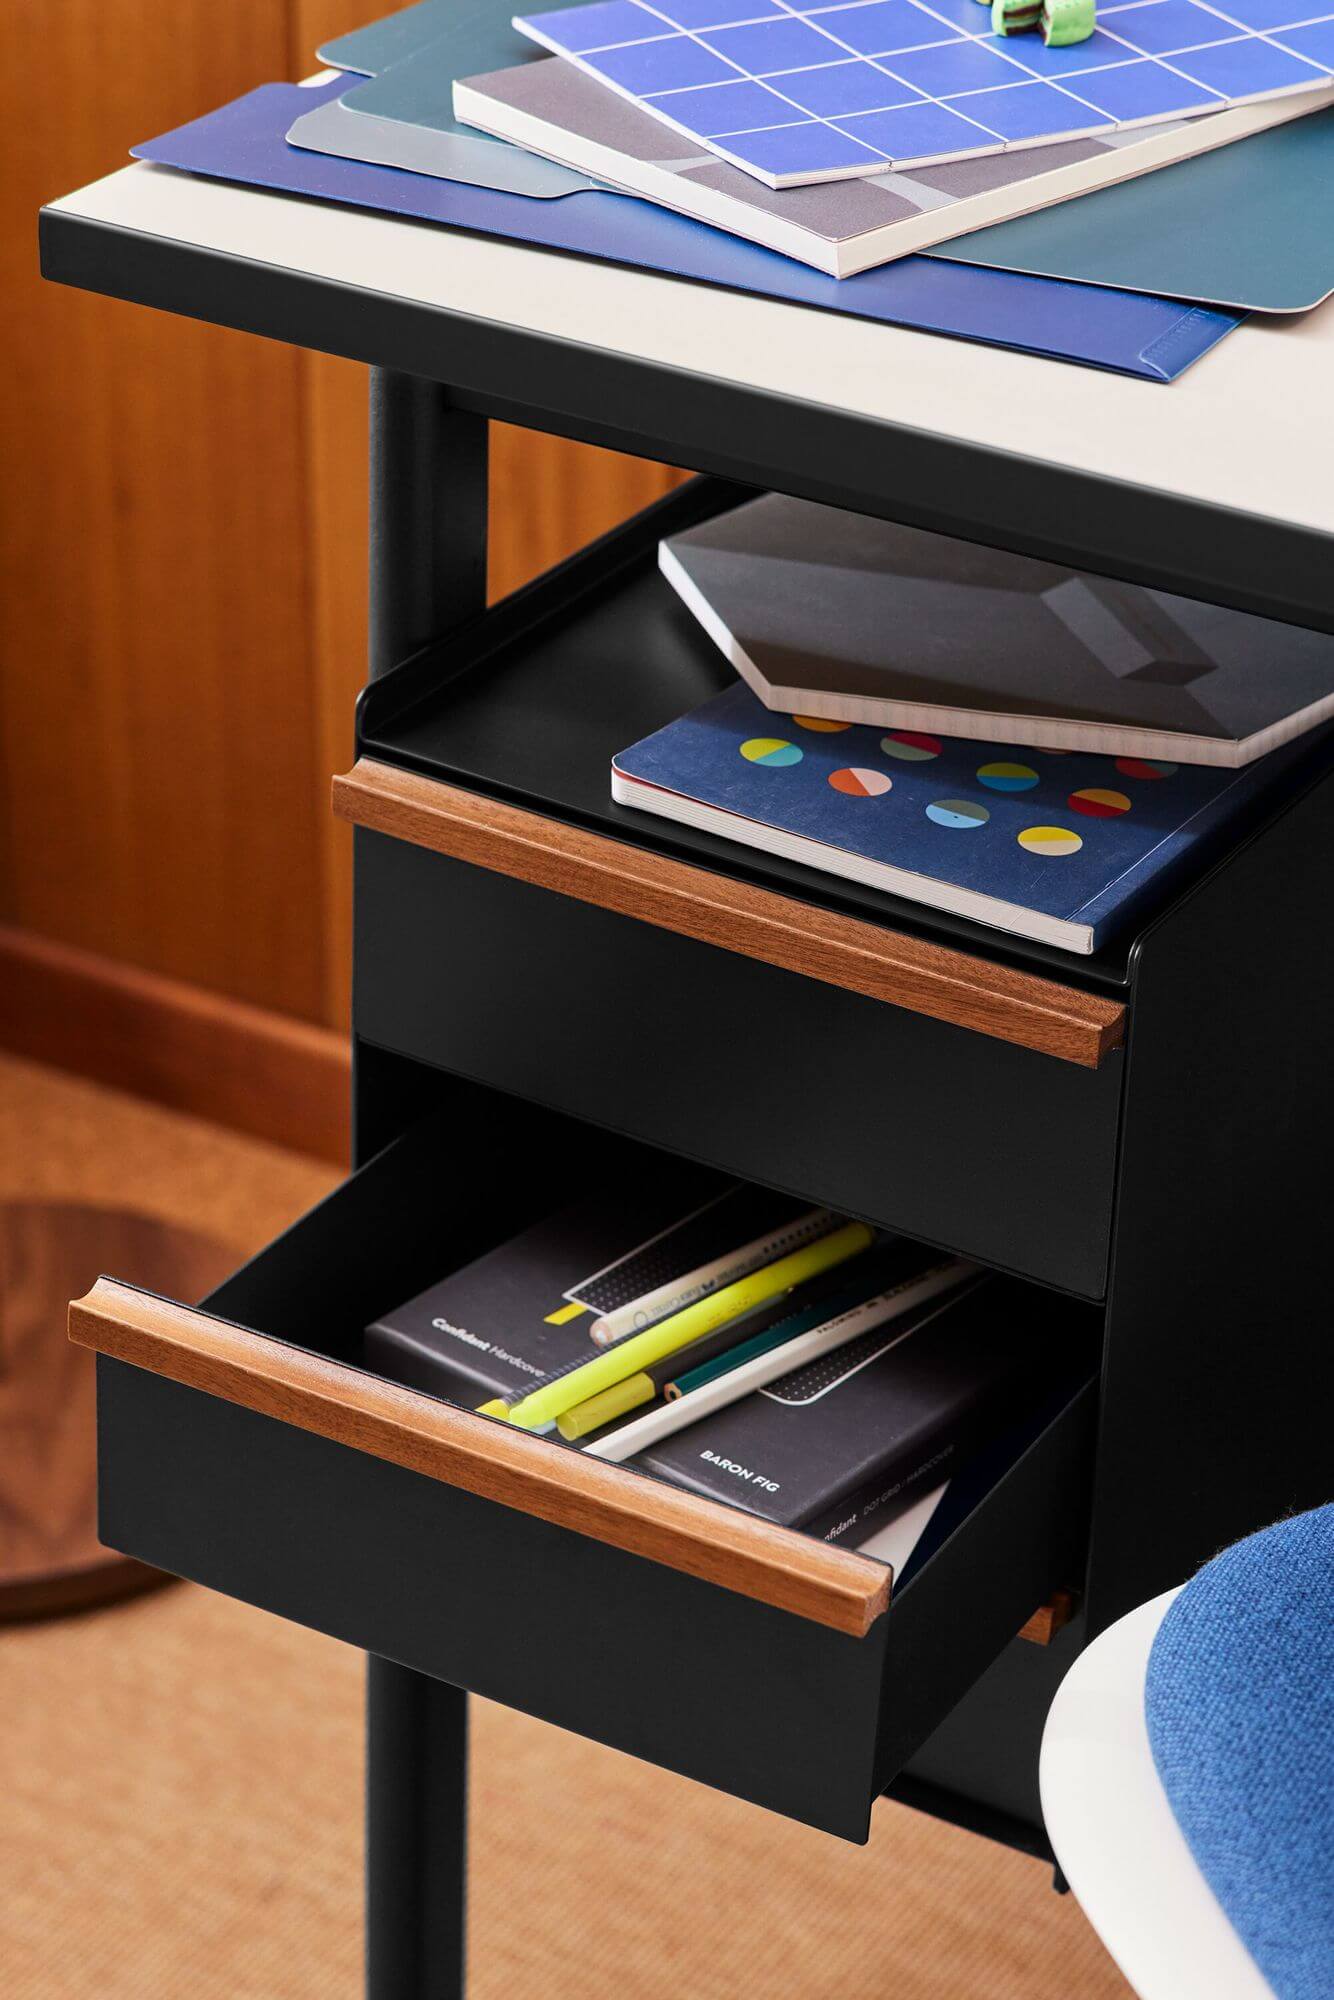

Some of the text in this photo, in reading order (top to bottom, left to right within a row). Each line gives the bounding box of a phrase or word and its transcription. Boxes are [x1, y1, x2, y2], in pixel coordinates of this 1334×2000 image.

[431, 1317, 546, 1378] Confidant Hardcove
[700, 1449, 781, 1493] BARON FIG
[824, 1513, 857, 1542] nfidant
